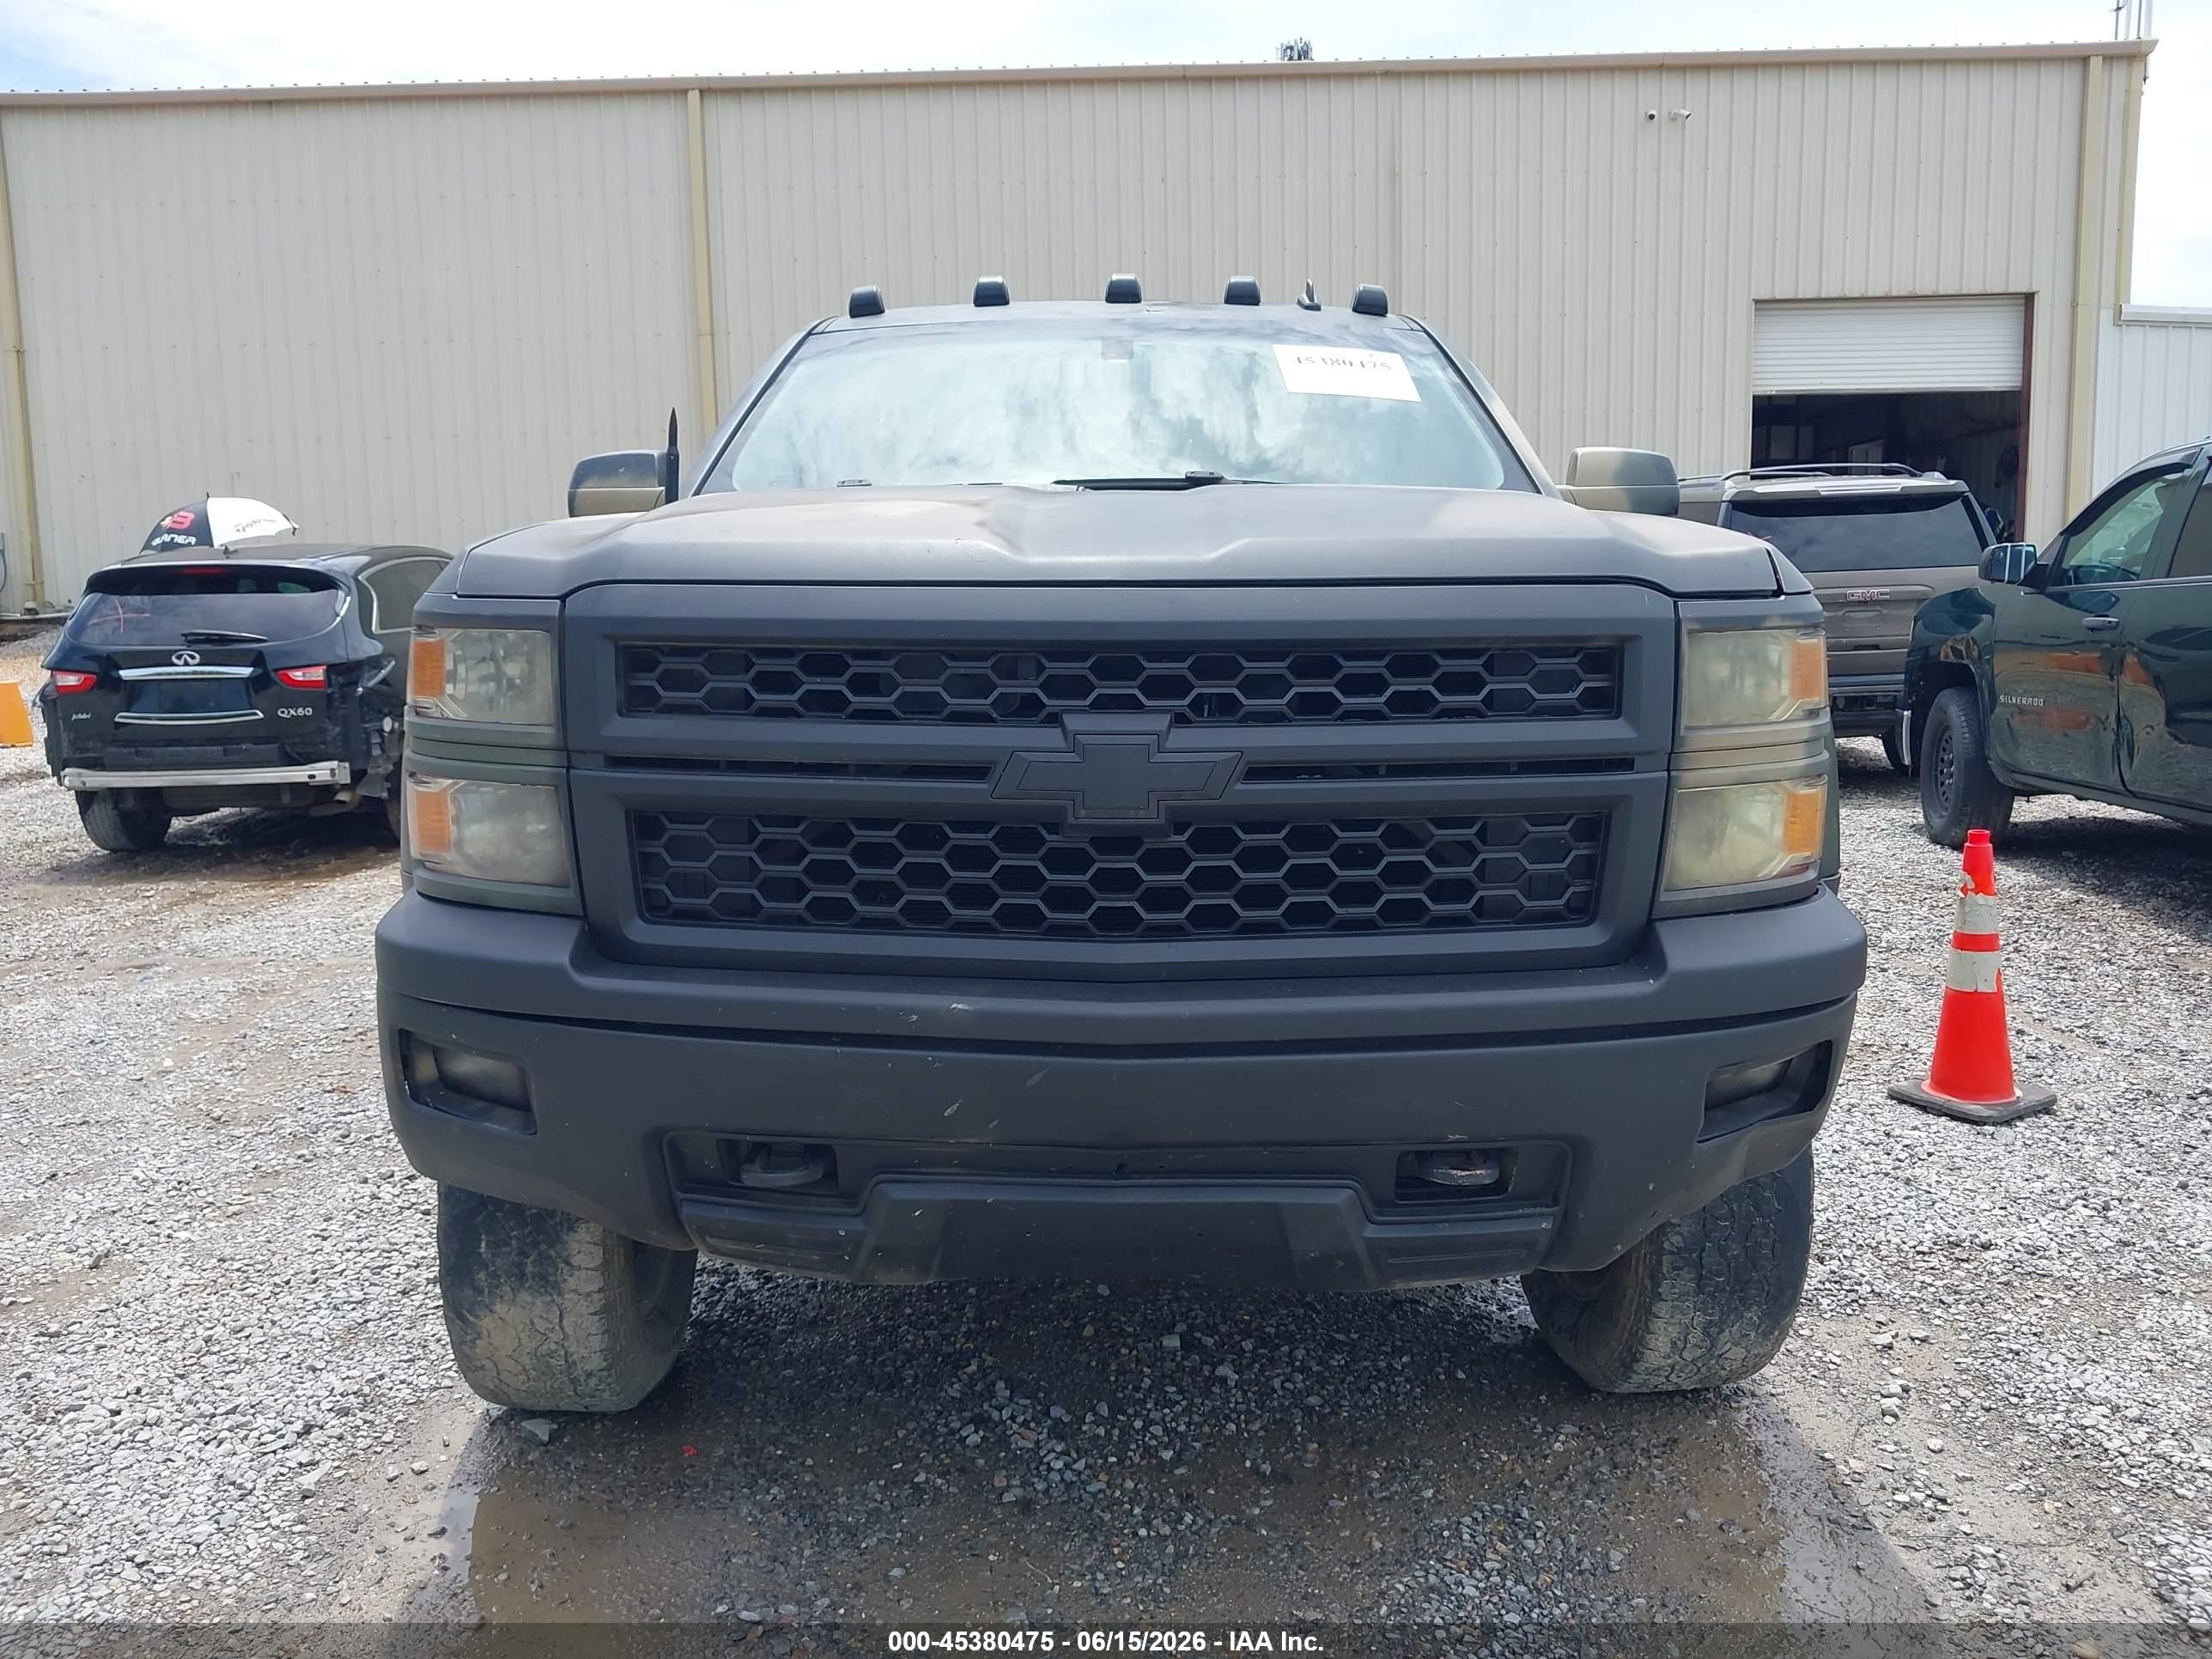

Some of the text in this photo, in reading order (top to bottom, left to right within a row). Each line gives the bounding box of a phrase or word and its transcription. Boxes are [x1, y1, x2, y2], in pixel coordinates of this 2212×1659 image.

[1846, 589, 1890, 601] GMC
[1999, 695, 2045, 707] SILVERADO
[277, 708, 313, 719] QX60
